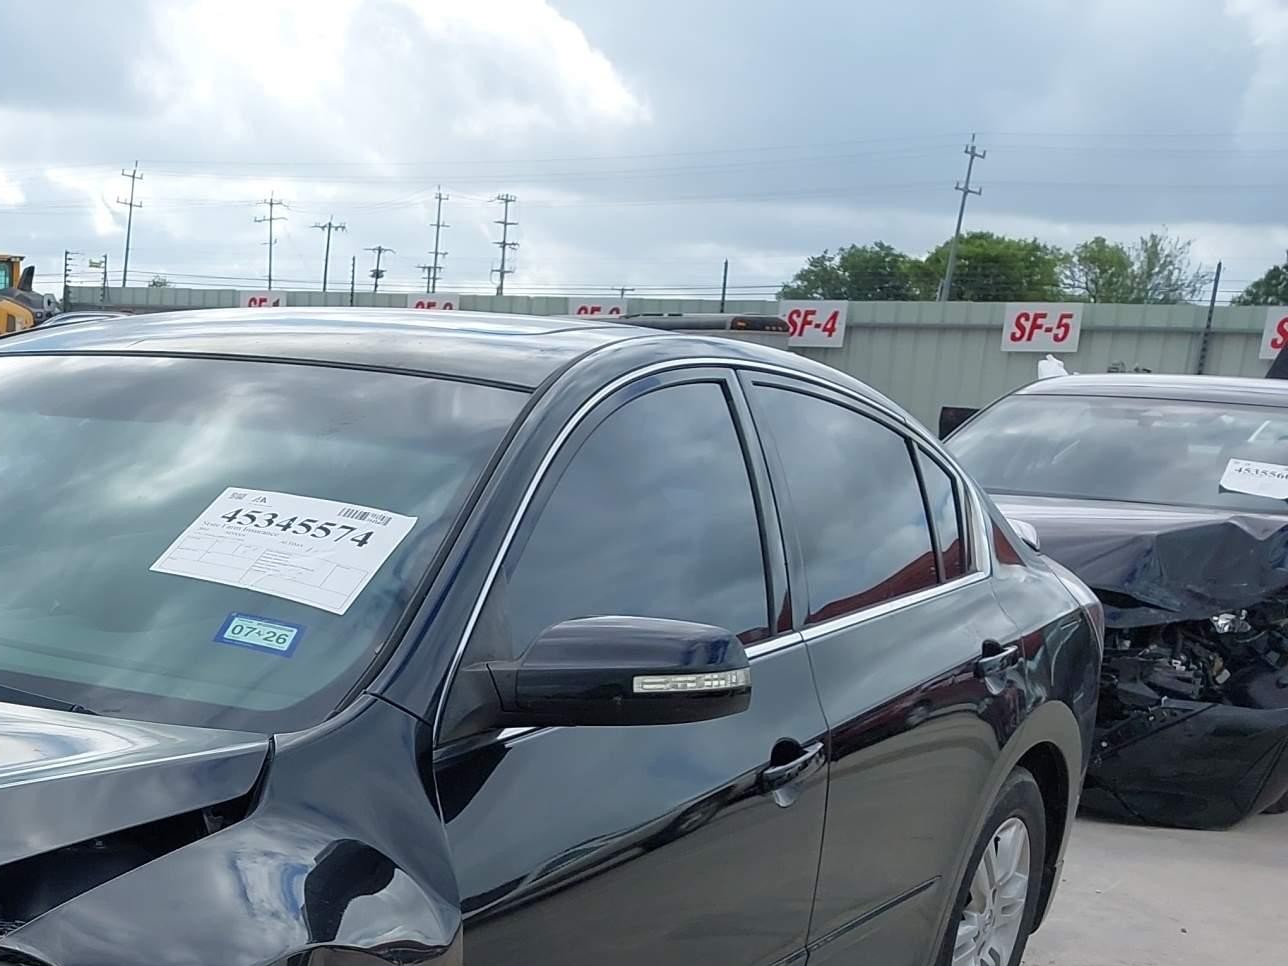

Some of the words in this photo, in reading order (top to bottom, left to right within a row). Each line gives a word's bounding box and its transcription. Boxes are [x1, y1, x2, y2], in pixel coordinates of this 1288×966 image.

[787, 309, 839, 337] SF-4
[1010, 312, 1074, 342] SF-5
[221, 508, 374, 548] 45345574
